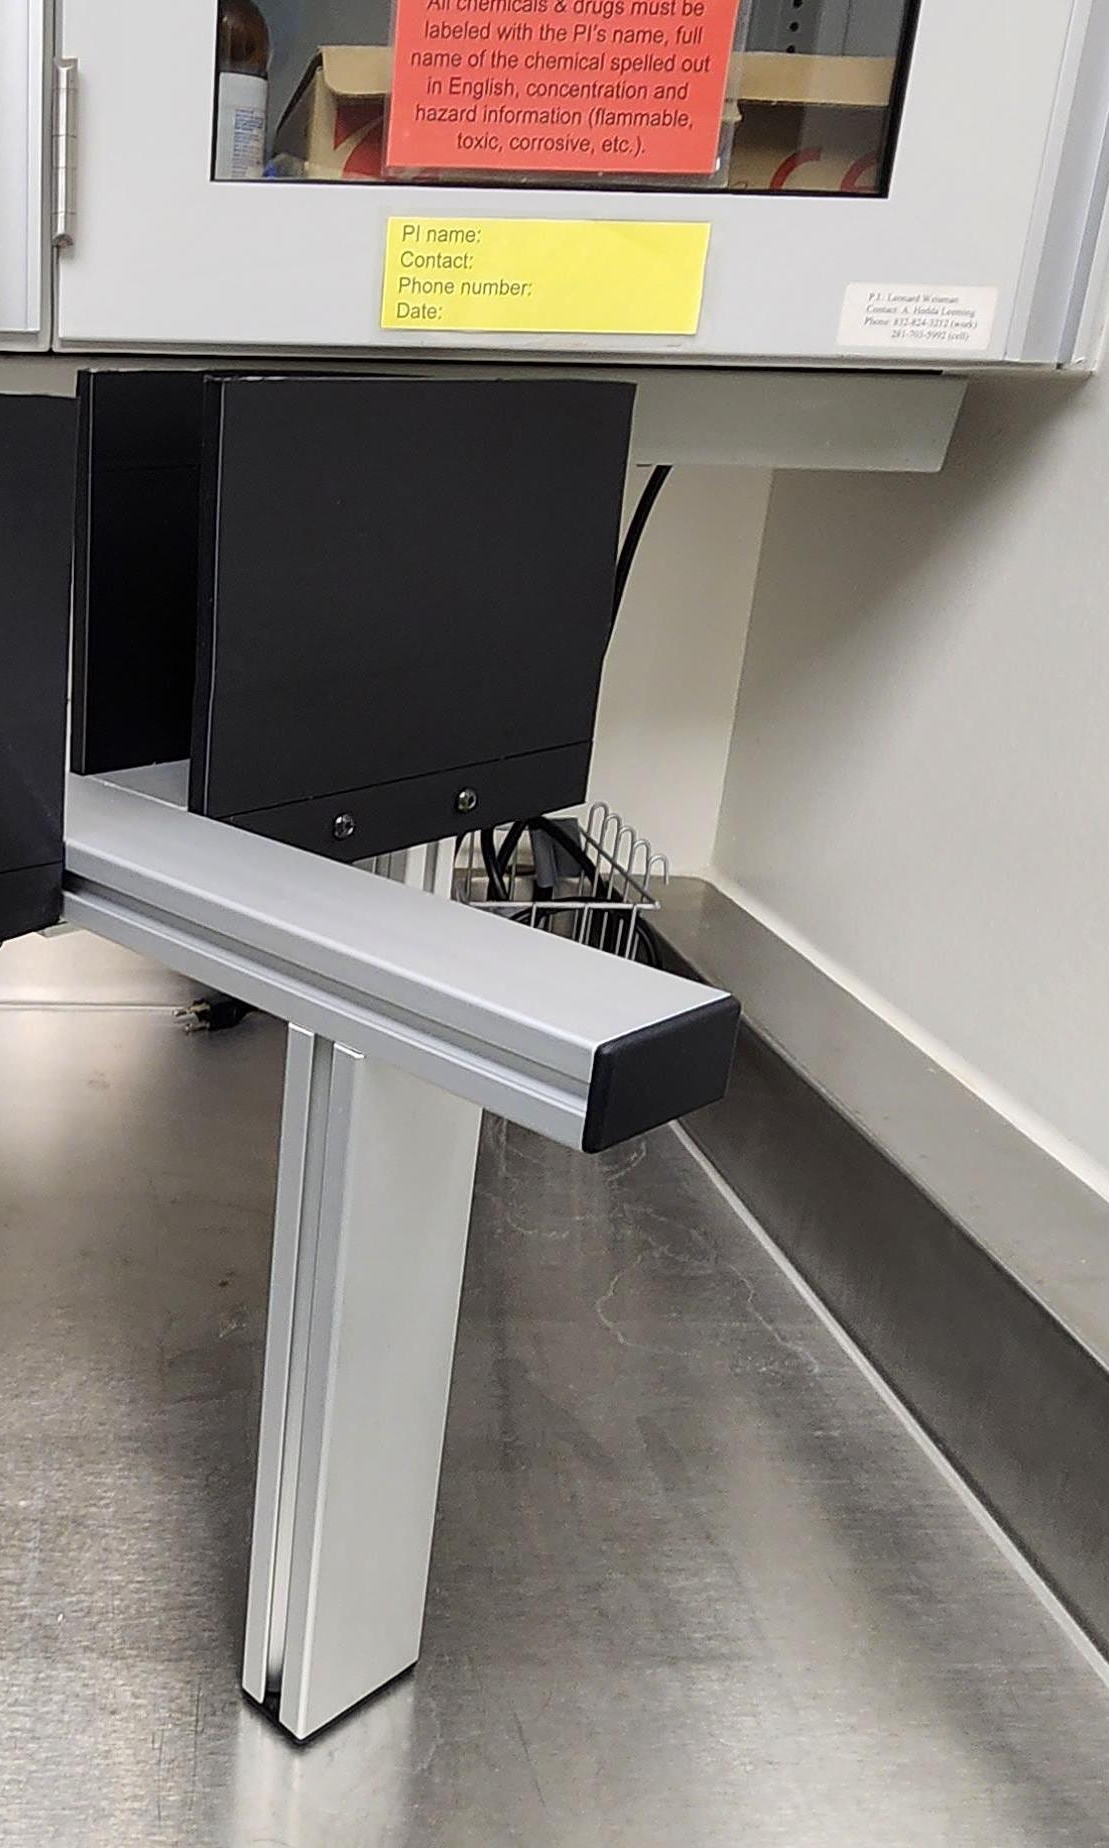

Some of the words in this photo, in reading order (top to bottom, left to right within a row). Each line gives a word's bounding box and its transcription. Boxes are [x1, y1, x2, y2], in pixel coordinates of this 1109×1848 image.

[426, 0, 450, 11] All
[457, 0, 548, 13] chemicals
[554, 0, 567, 13] &
[573, 0, 625, 19] drugs
[631, 0, 676, 16] must
[682, 0, 705, 17] be
[424, 20, 491, 40] labeled
[497, 22, 533, 42] with
[540, 23, 567, 42] the
[573, 24, 607, 43] PI's
[612, 28, 669, 47] name,
[675, 25, 703, 45] full
[410, 51, 462, 68] name
[467, 49, 487, 68] of
[491, 50, 519, 69] the
[524, 51, 606, 71] chemical
[610, 53, 677, 76] spelled
[682, 56, 711, 73] out
[426, 76, 442, 95] in
[449, 76, 520, 100] English,
[526, 79, 648, 100] concentration
[653, 82, 689, 101] and
[415, 103, 477, 122] hazard
[483, 104, 582, 125] information
[588, 107, 694, 129] (flammable,
[457, 132, 503, 153] toxic,
[509, 134, 595, 154] corrosive,
[602, 136, 645, 157] etc.).
[402, 224, 421, 242] PI
[426, 227, 482, 244] name:
[400, 250, 474, 270] Contact:
[398, 276, 455, 295] Phone
[460, 278, 533, 297] number:
[396, 301, 443, 320] Date:
